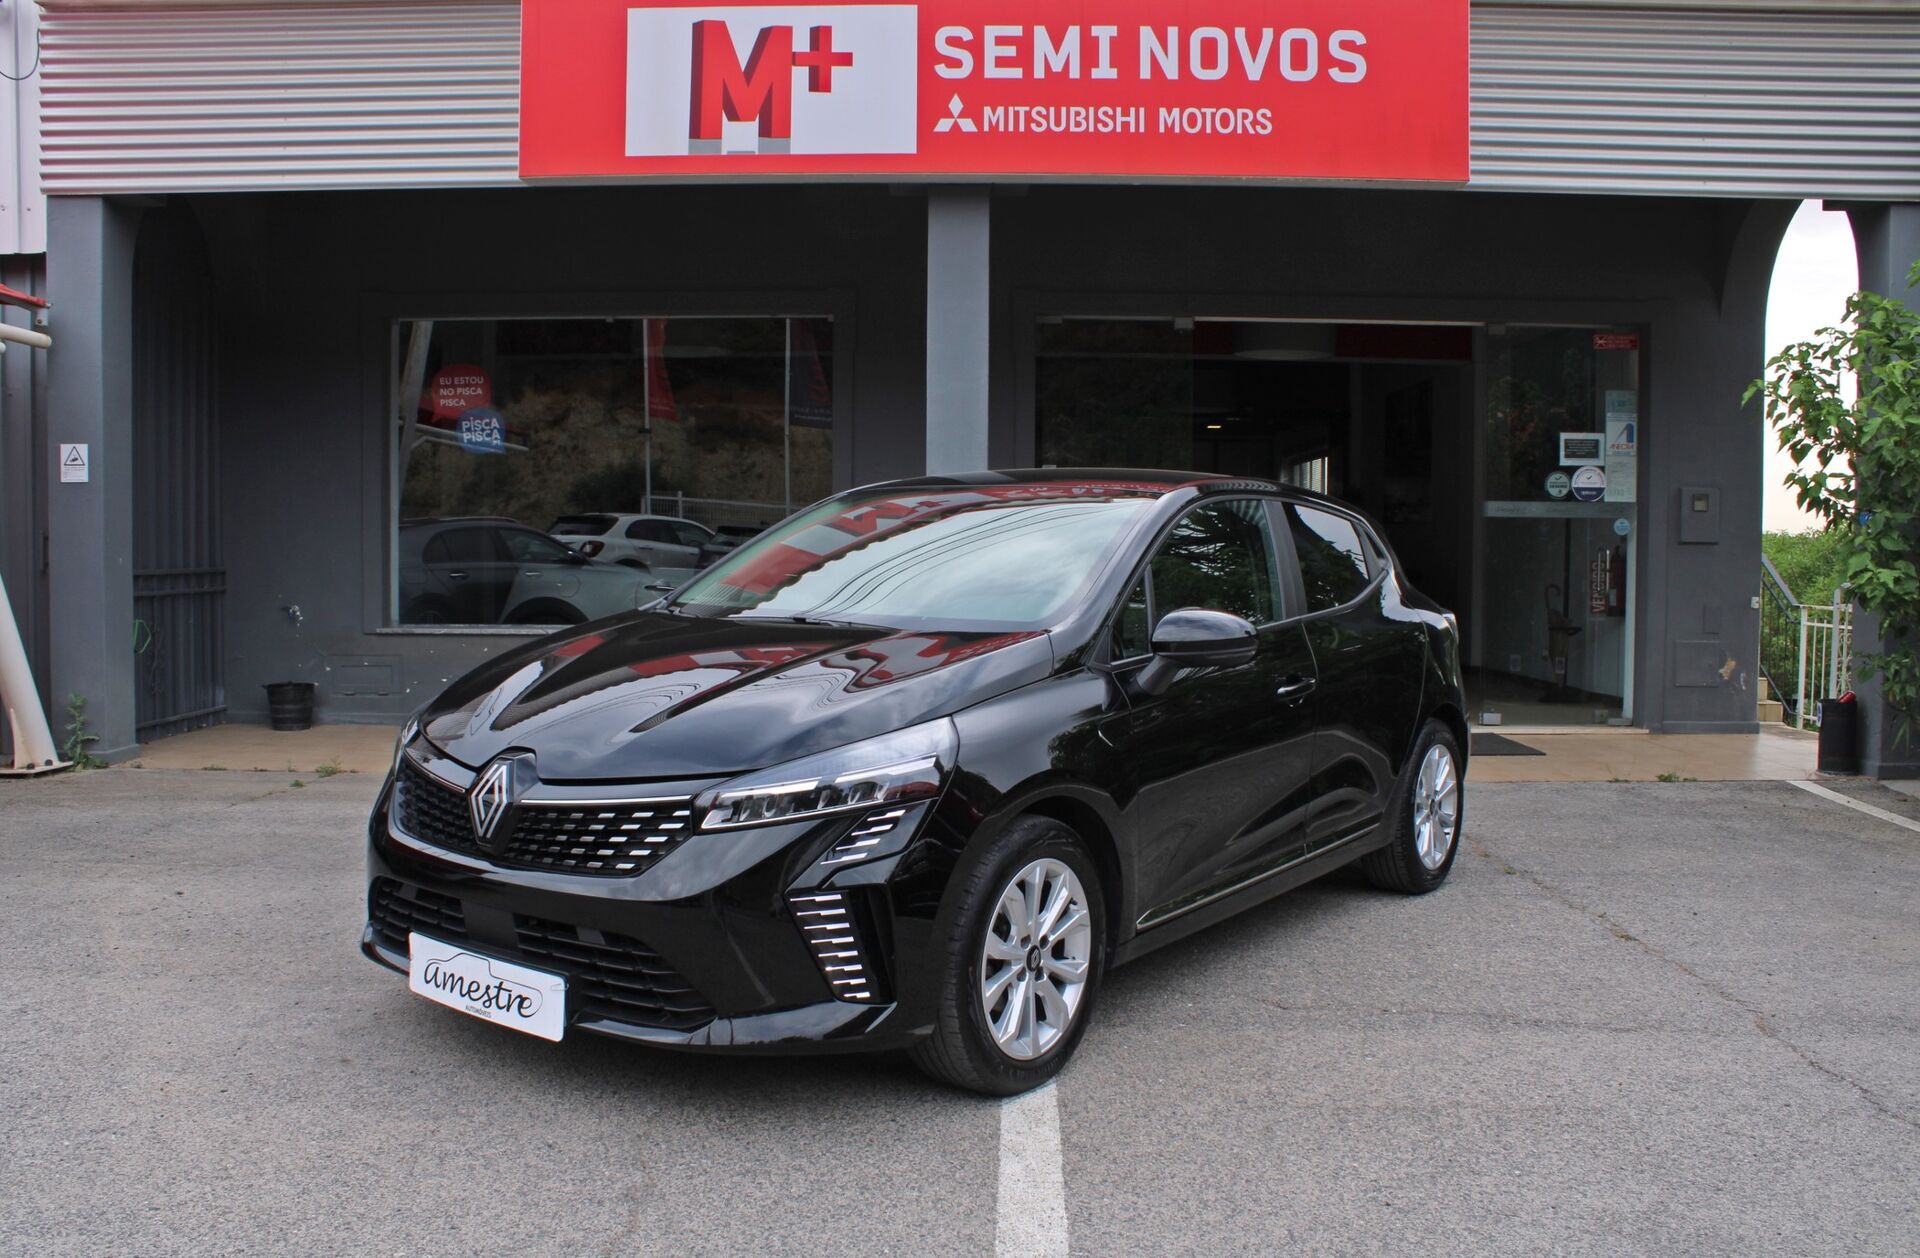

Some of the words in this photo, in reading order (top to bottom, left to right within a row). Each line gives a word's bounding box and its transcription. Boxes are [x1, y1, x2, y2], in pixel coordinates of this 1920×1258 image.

[933, 25, 1118, 80] SEMI
[1139, 26, 1368, 83] NOVOS
[983, 106, 1145, 133] MITSUBISHI
[1159, 107, 1273, 135] MOTORS
[440, 377, 452, 385] EU
[454, 376, 484, 384] ESTOU
[440, 388, 454, 396] NO
[456, 387, 482, 395] PISCA
[440, 399, 466, 407] PISCA
[463, 429, 501, 443] PISCA
[424, 961, 535, 1018] amestre
